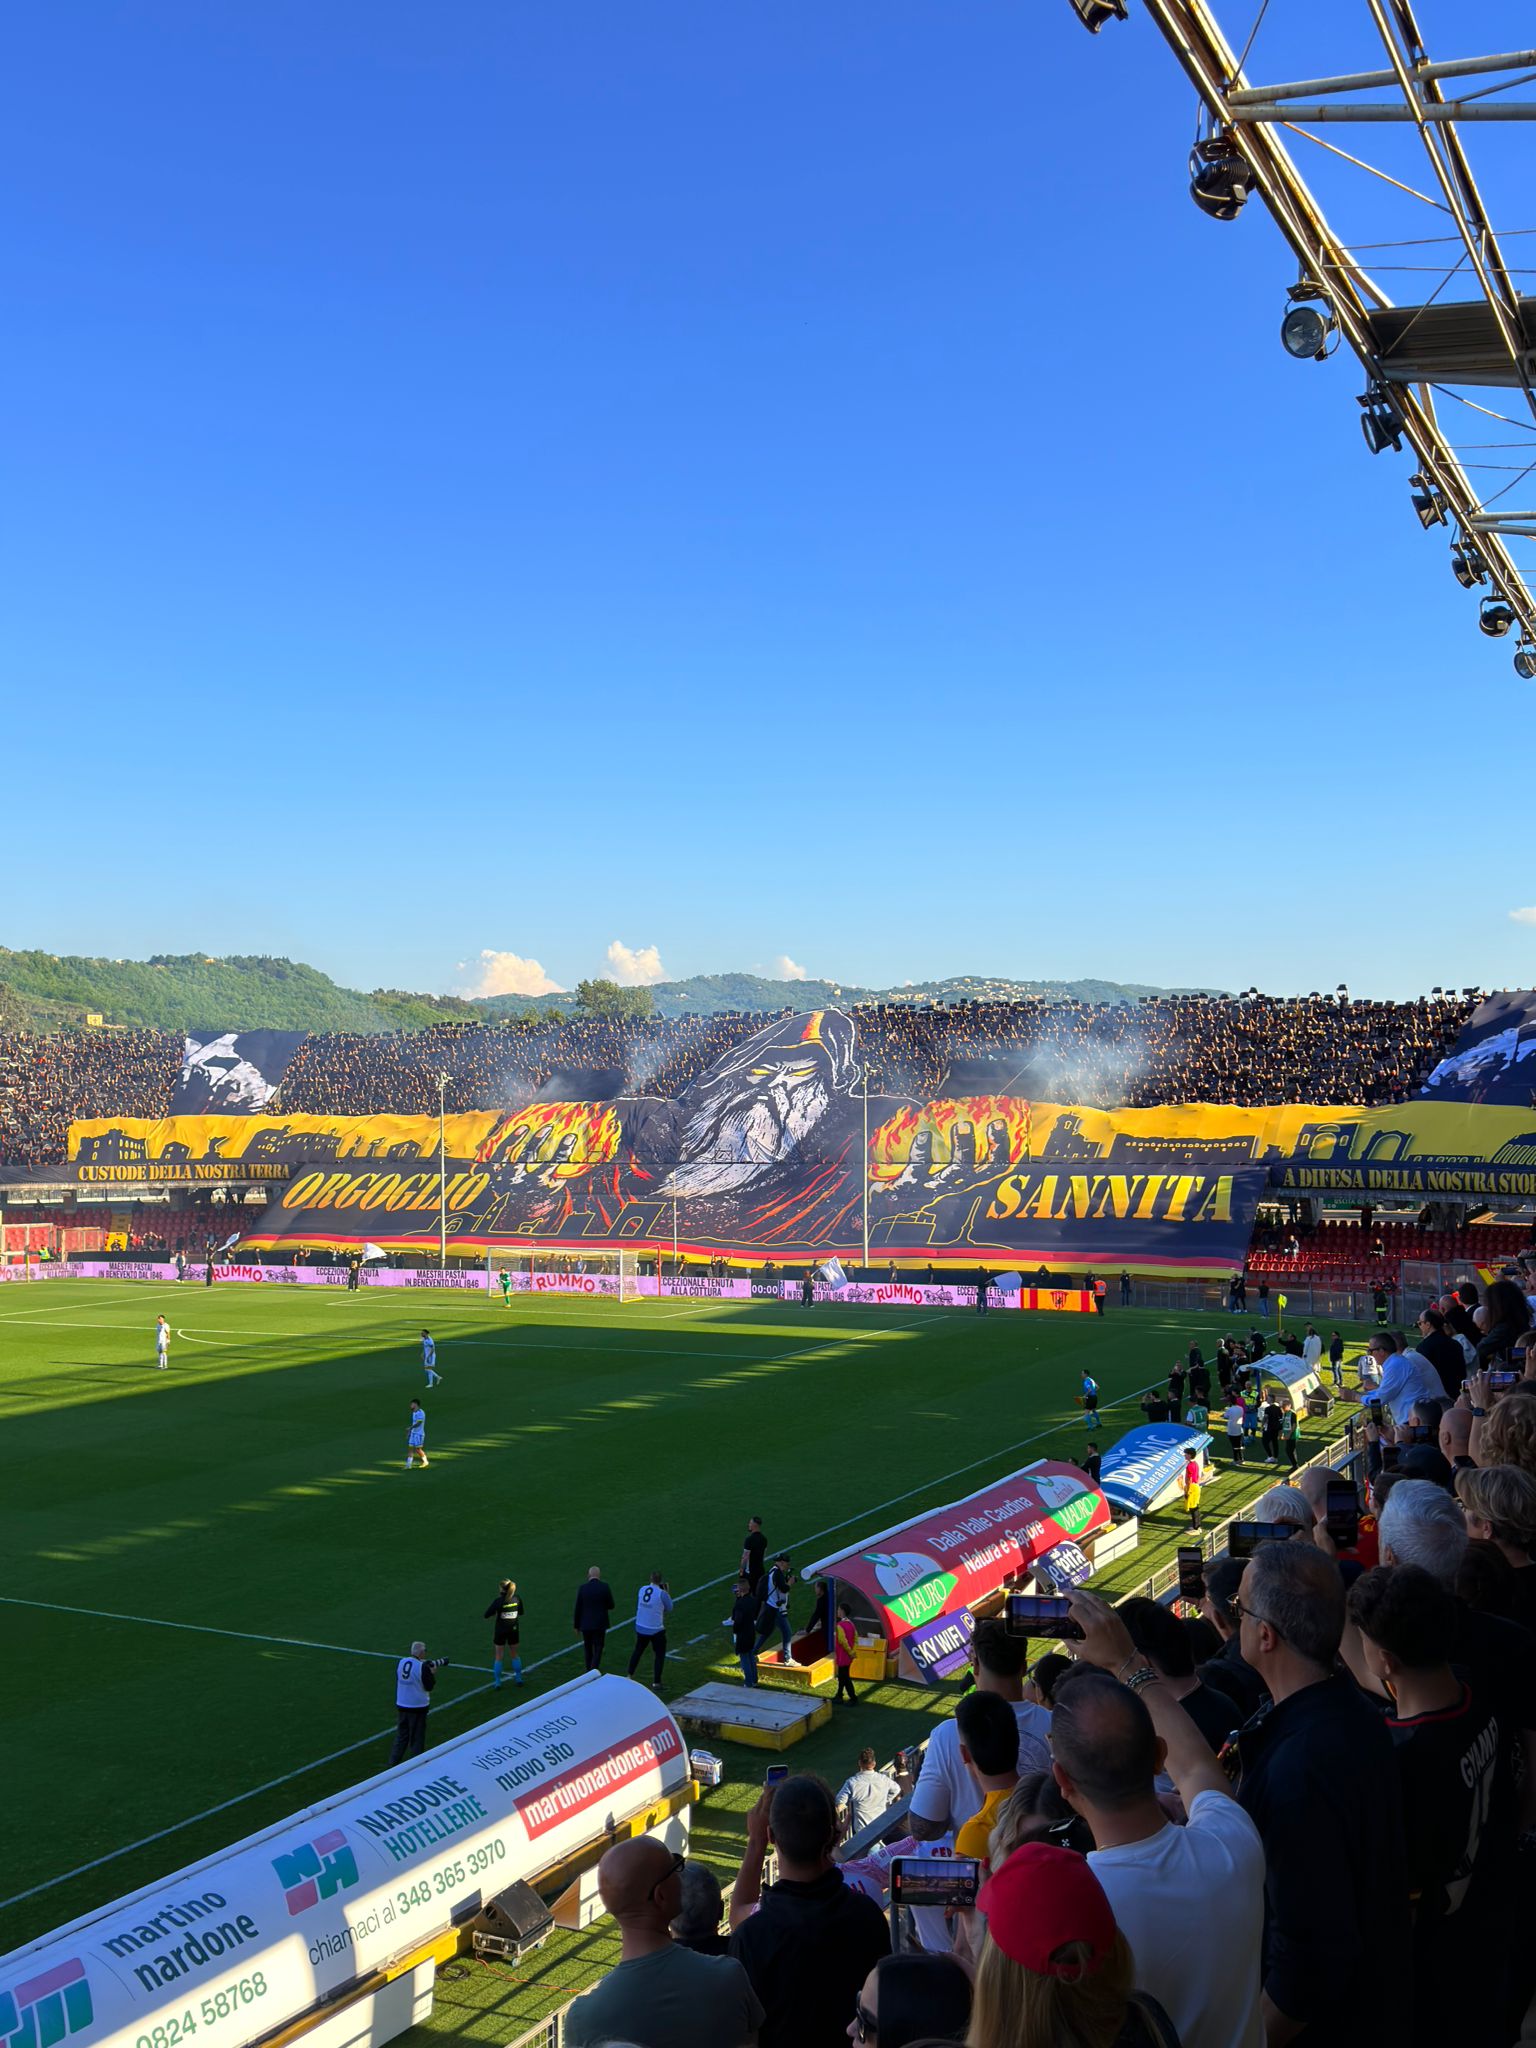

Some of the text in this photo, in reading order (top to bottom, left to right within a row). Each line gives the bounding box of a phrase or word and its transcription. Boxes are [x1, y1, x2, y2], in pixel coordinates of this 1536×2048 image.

[78, 1163, 290, 1181] CUSTODE DELLA NOSTRA TERRA
[1283, 1167, 1296, 1187] A
[1300, 1168, 1366, 1189] DIFESA
[1368, 1169, 1424, 1191] DELLA
[1427, 1171, 1498, 1193] NOSTRA
[281, 1171, 491, 1212] ORGOGLIO
[985, 1174, 1234, 1222] SANNITA
[105, 1270, 138, 1279] BENEVENTO
[109, 1262, 132, 1271] MAESTRI
[212, 1265, 262, 1282] RUMMO
[405, 1277, 480, 1289] IN BENEVENTO DAL 1846
[416, 1270, 467, 1279] MAESTRI PASTAI
[536, 1274, 595, 1293] RUMMO
[706, 1278, 734, 1289] TENUTA
[670, 1286, 722, 1297] ALLA COTTURA
[751, 1284, 778, 1294] 00:00
[876, 1284, 923, 1305] RUMMO
[927, 1495, 1034, 1553] Dalla Valle Caudina
[1057, 1496, 1094, 1532] MAURO
[959, 1520, 1045, 1576] Natura e Sapore
[642, 1586, 654, 1603] 8
[898, 1578, 947, 1624] MAURO
[911, 1624, 967, 1669] SKY WIFI
[402, 1660, 413, 1680] 9
[471, 1714, 578, 1772] visita il nostro
[495, 1741, 575, 1792] nuovo sito
[524, 1728, 675, 1829] martinonardone.com
[355, 1775, 469, 1838] NARDONE
[382, 1794, 489, 1863] HOTELLERIE
[308, 1838, 507, 1967] chiamaci al 348 365 3970
[102, 1891, 228, 1959] martino
[133, 1914, 260, 1993] nardone
[200, 1971, 268, 2026] 58768
